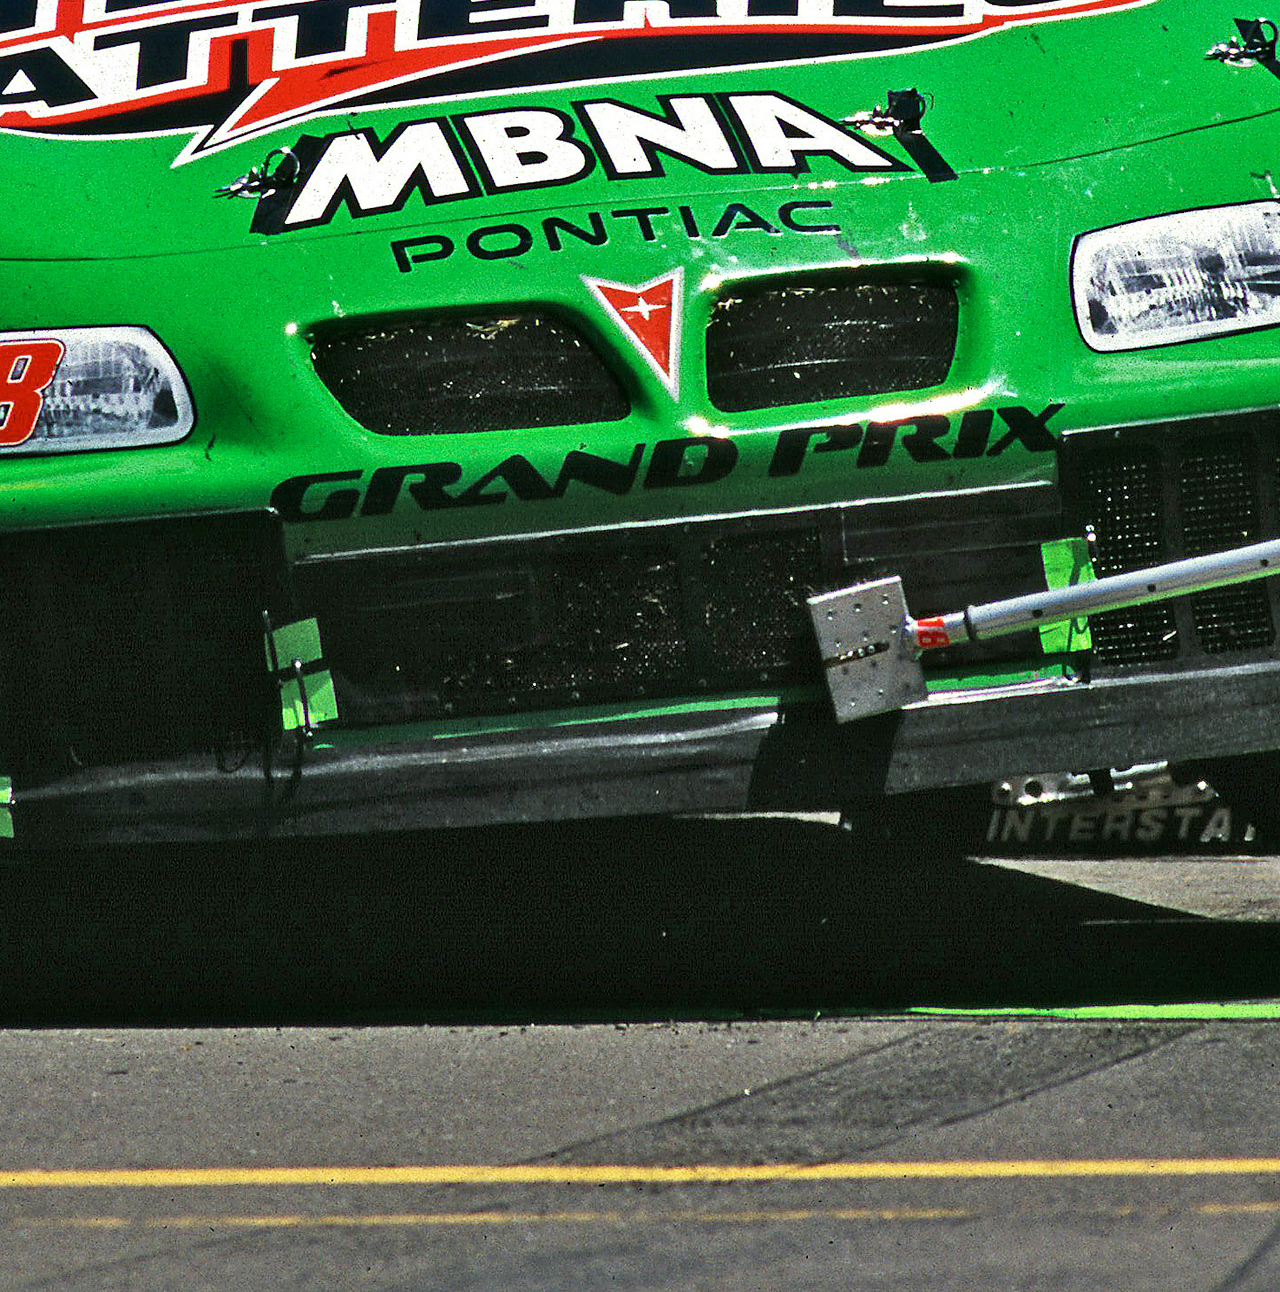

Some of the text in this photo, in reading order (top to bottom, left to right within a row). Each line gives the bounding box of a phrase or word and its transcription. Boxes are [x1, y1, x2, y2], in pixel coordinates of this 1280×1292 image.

[280, 92, 902, 228] MBNA
[392, 199, 842, 274] PONTIAC
[269, 402, 1066, 525] GRAND PRIX
